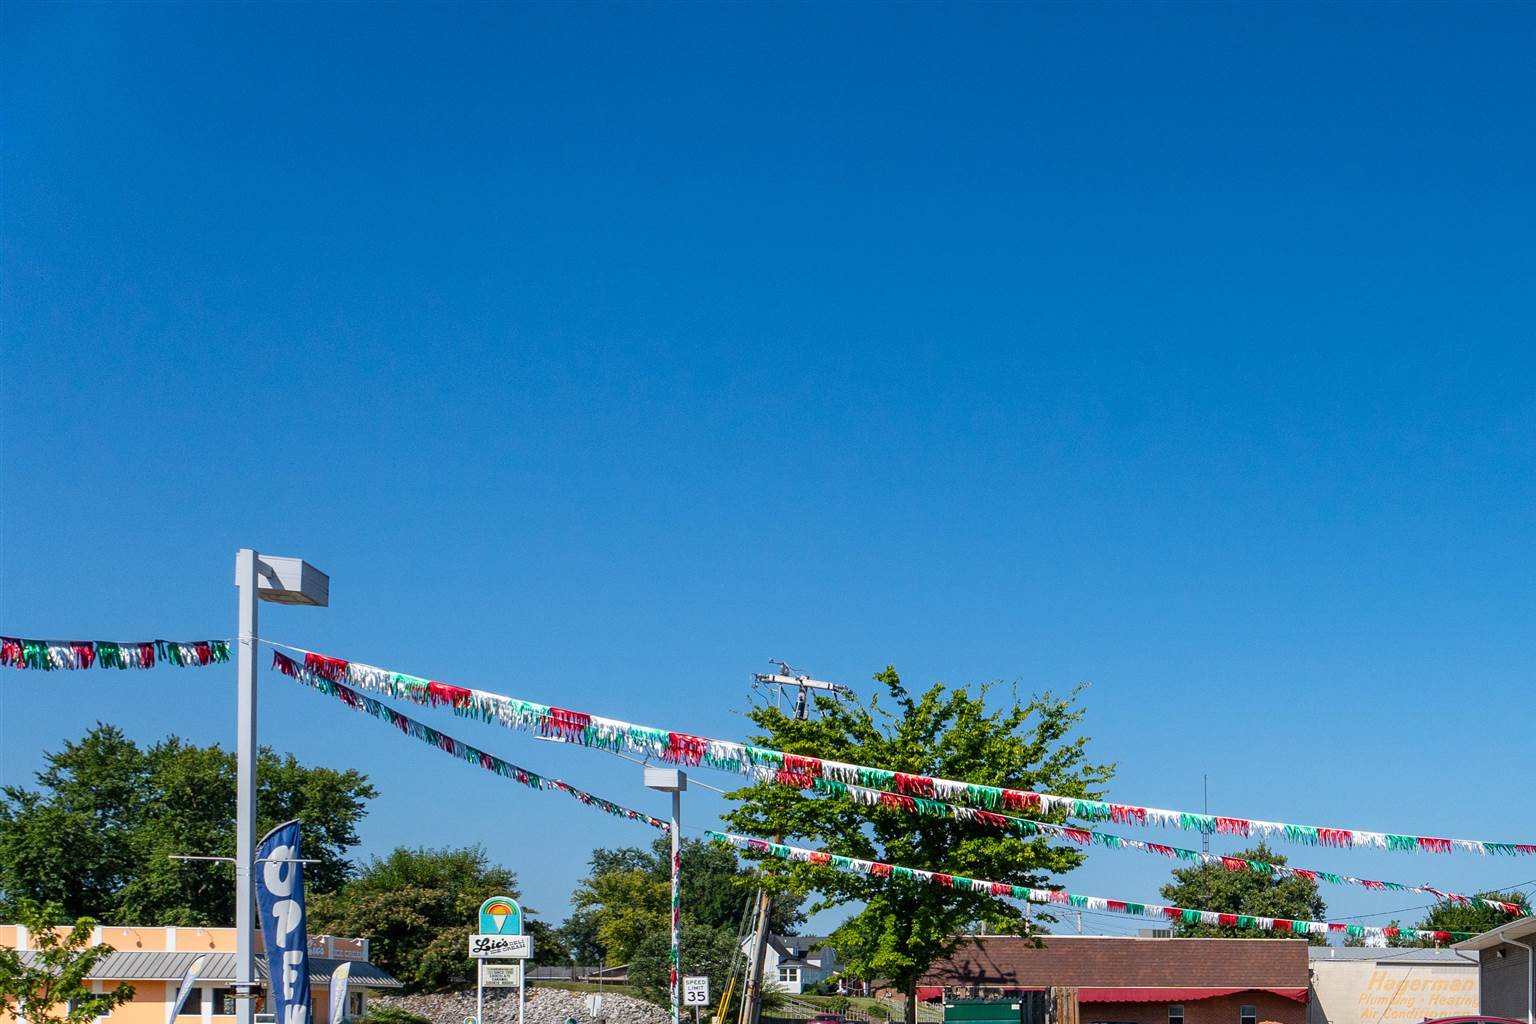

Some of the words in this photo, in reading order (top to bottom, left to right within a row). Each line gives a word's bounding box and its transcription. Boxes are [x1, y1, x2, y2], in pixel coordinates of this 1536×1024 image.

[472, 937, 508, 953] Lic's
[502, 943, 526, 953] CREAM
[1367, 970, 1474, 993] Hagerman
[687, 991, 706, 1002] 35
[1359, 993, 1416, 1007] Plumbing
[1429, 993, 1478, 1008] Heating
